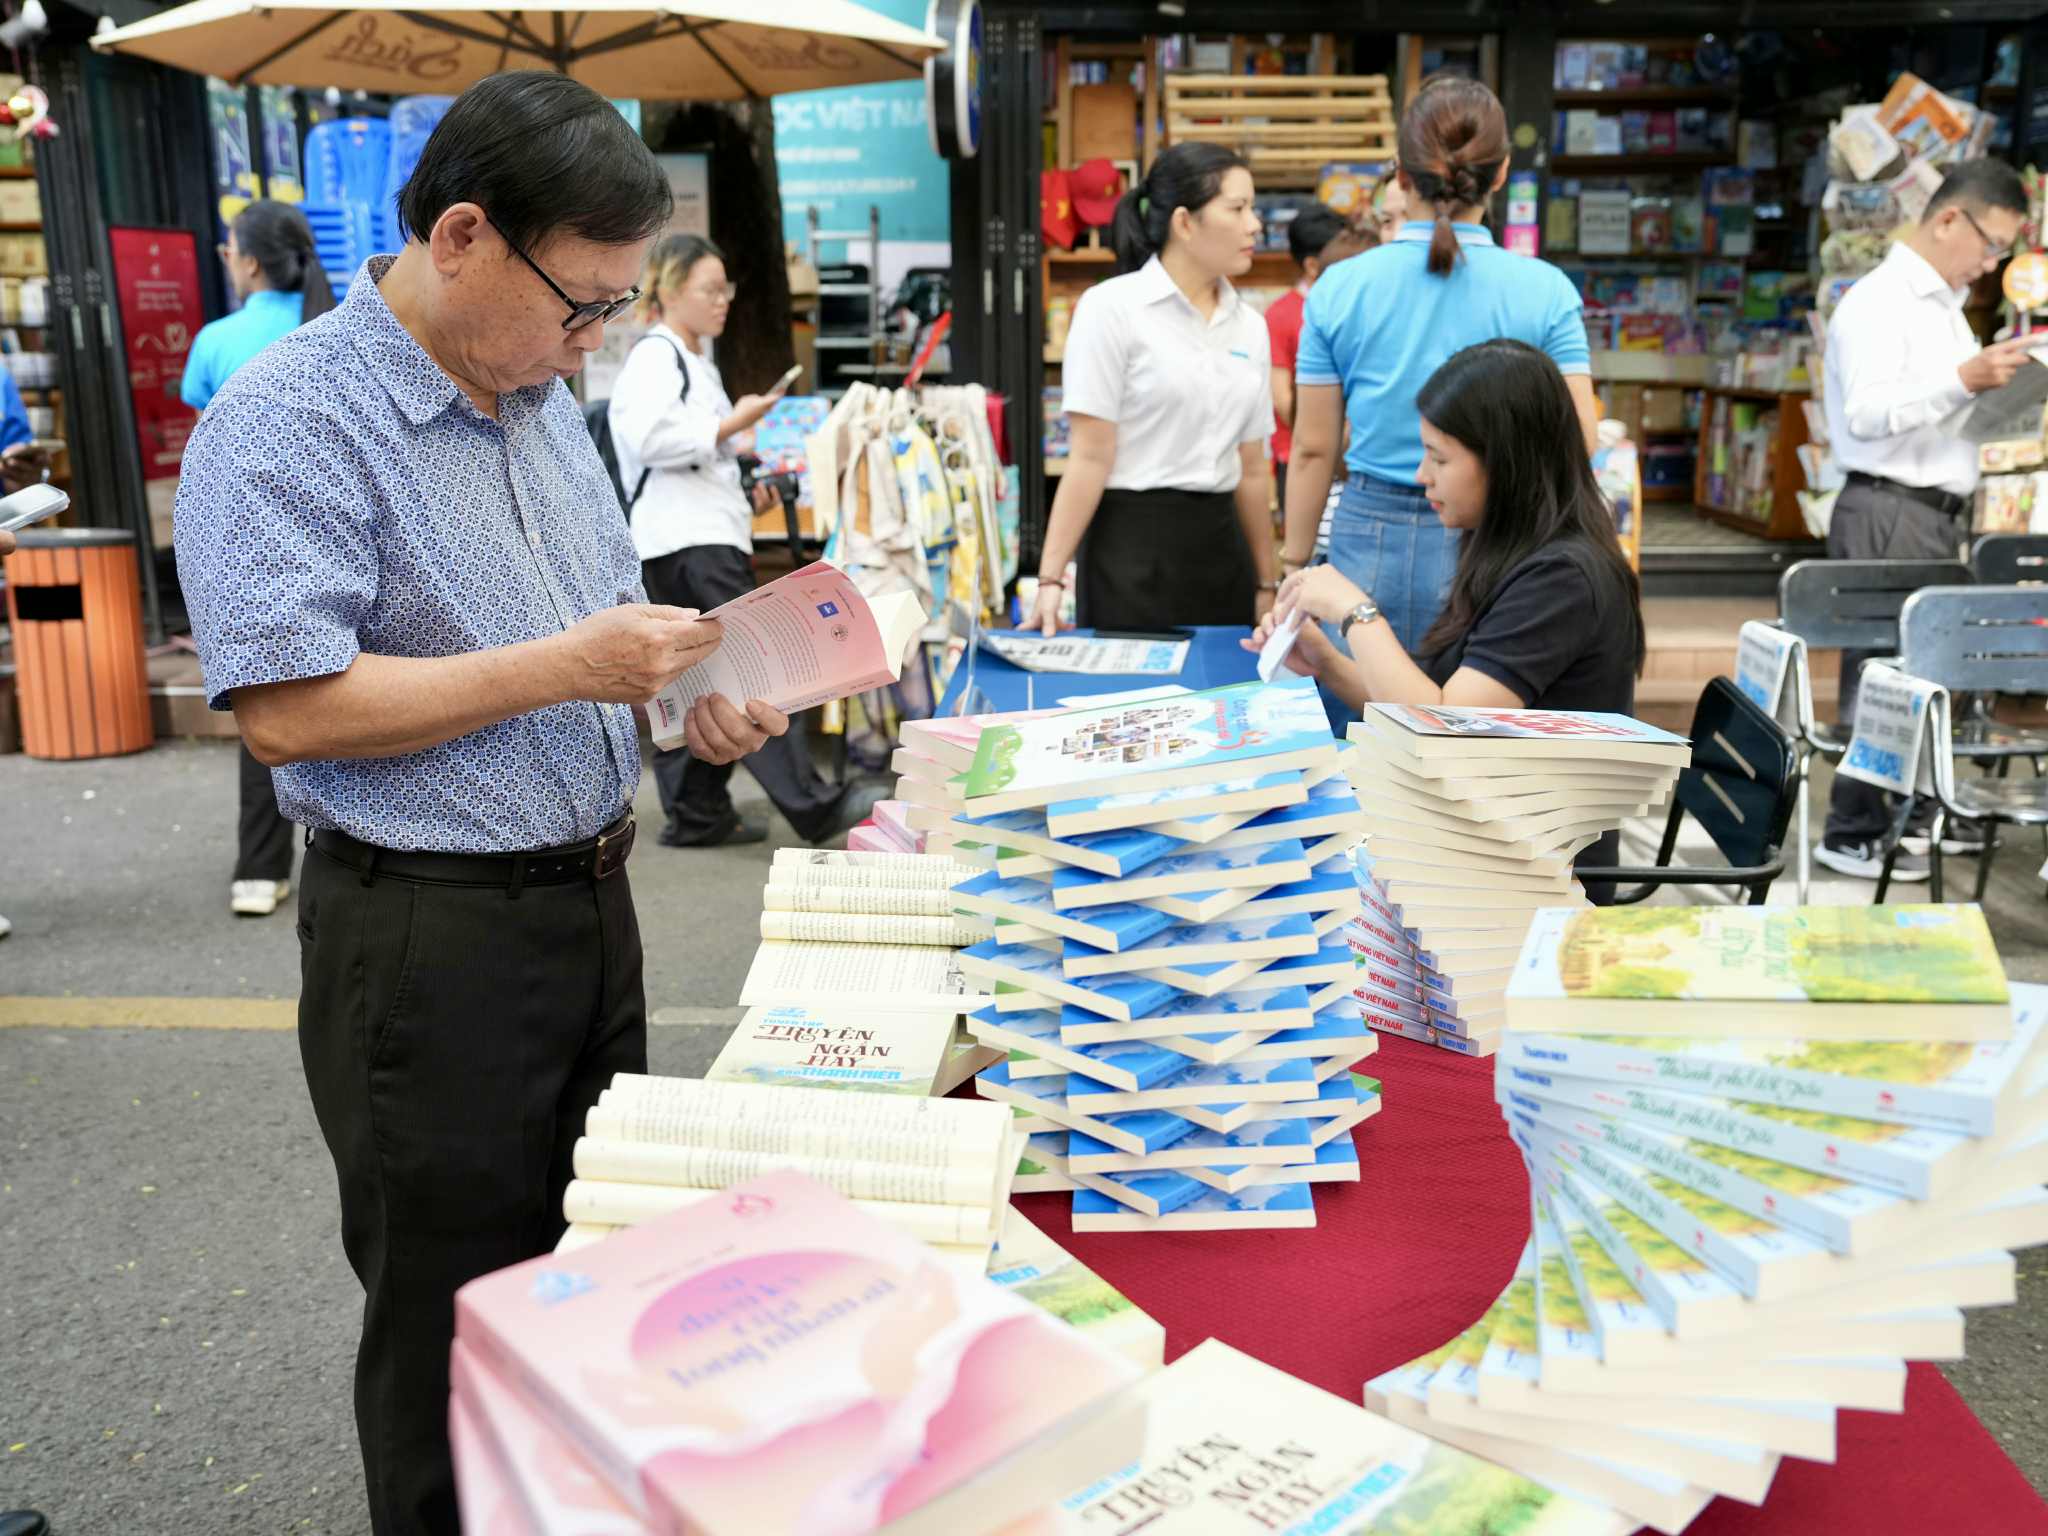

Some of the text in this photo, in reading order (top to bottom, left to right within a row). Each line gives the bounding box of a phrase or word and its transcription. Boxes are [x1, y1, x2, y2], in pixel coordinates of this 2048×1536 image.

[816, 96, 886, 132] VIỆT
[1380, 975, 1397, 989] NAM
[1381, 998, 1399, 1011] NAM
[1383, 1018, 1404, 1032] NAM
[759, 1026, 875, 1043] TRUYỆN
[797, 1056, 865, 1068] HAY
[1248, 1472, 1325, 1530] HAY
